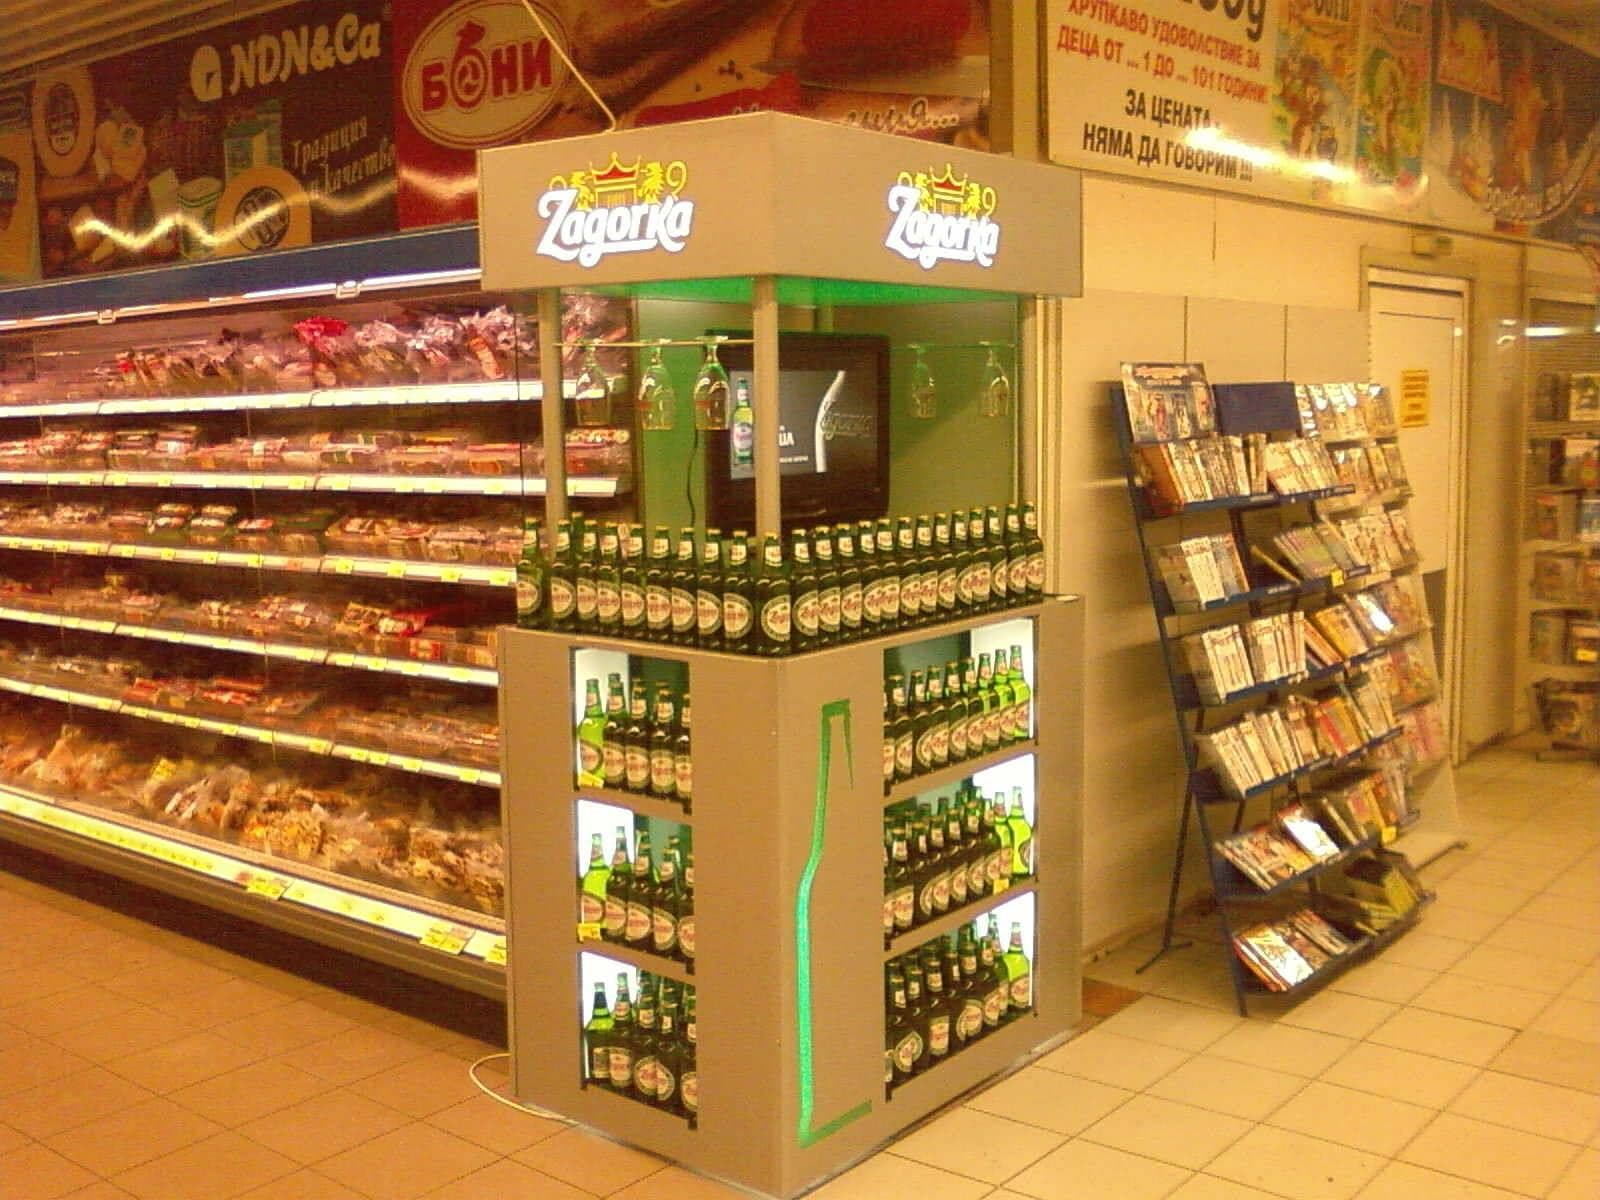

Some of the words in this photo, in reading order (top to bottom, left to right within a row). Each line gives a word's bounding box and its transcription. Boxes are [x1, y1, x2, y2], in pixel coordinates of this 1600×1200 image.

[421, 36, 552, 112] БОНИ
[1056, 24, 1100, 58] ДЕЦА
[1103, 38, 1124, 64] ОТ
[1152, 53, 1175, 78] ДО
[1192, 65, 1214, 92] 101
[1124, 88, 1146, 120] ЗА
[1082, 122, 1134, 160] НЯМА
[1136, 134, 1161, 168] ДА
[1164, 140, 1237, 180] ГОВОРИМ
[536, 187, 695, 268] Zagorka
[885, 183, 1000, 270] Zagorka
